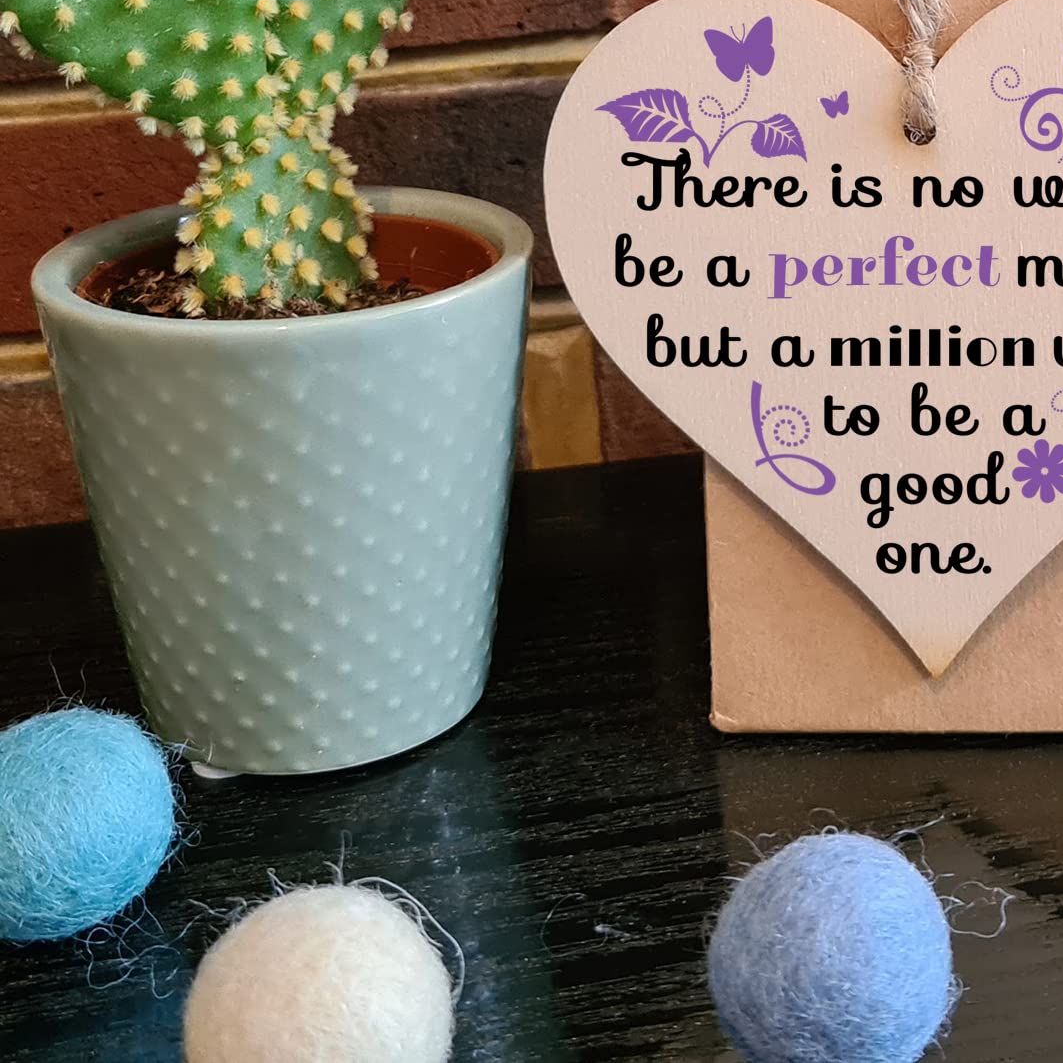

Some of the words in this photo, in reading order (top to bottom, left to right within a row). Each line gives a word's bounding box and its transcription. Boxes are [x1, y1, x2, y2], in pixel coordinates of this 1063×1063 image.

[621, 148, 808, 212] There
[831, 164, 883, 208] is
[912, 176, 984, 208] no
[615, 233, 684, 288] be
[706, 256, 751, 288] a
[769, 236, 1000, 298] perfect
[646, 314, 748, 368] but
[771, 336, 815, 368] a
[830, 325, 1035, 368] million
[823, 396, 880, 437] to
[911, 382, 980, 437] be
[1002, 405, 1047, 437] a
[860, 451, 1010, 529] good
[875, 543, 992, 575] one.
